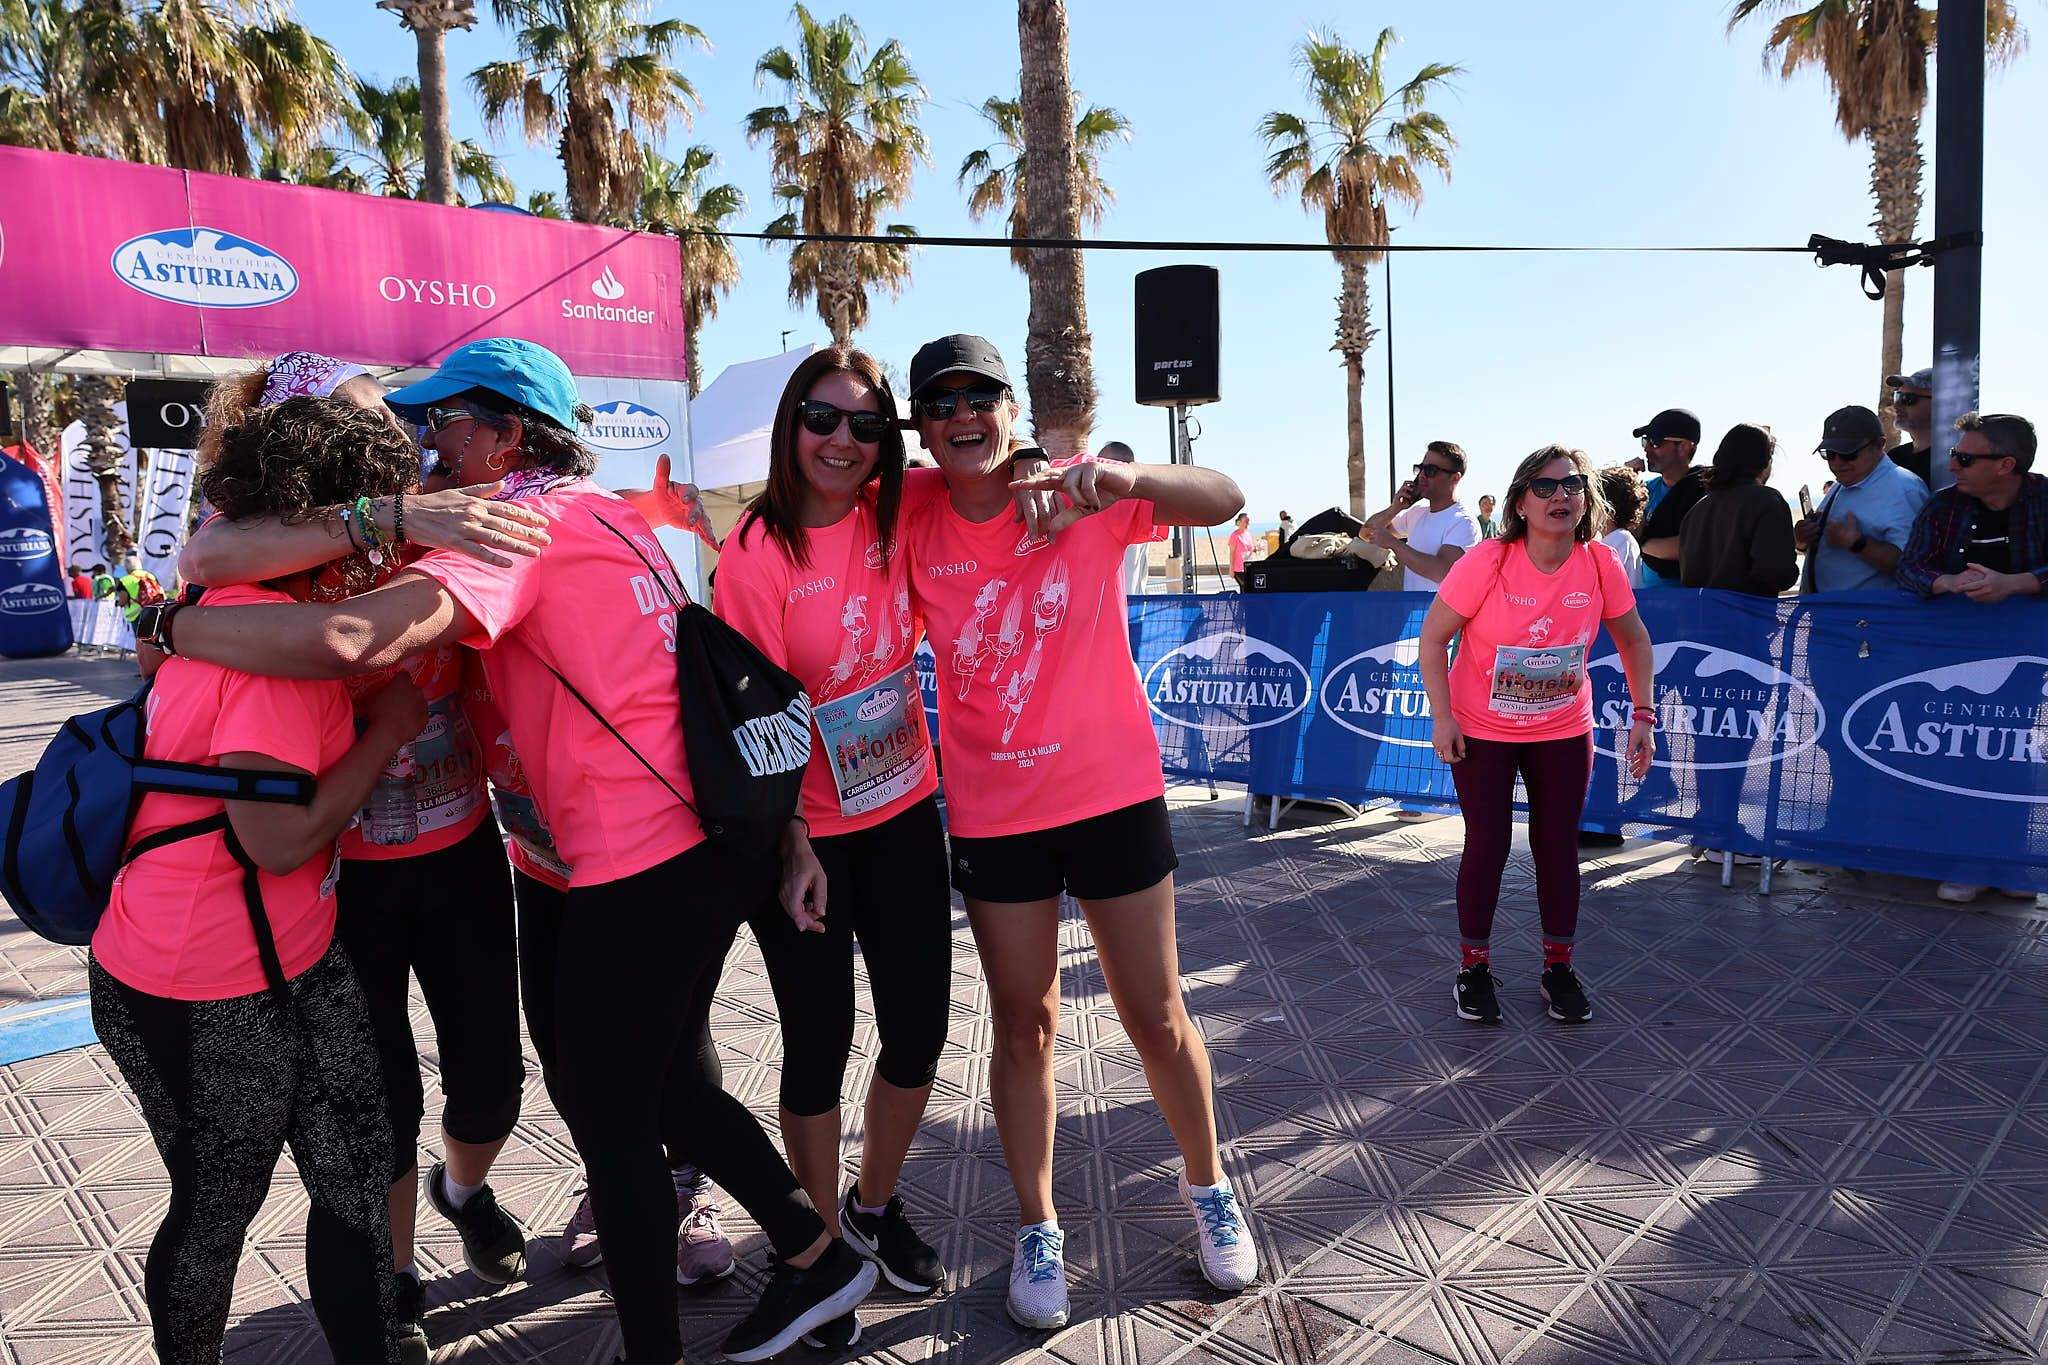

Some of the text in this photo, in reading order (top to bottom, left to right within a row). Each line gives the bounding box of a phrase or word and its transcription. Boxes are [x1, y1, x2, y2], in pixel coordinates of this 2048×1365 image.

[130, 250, 286, 292] ASTURIANA
[221, 257, 278, 269] LECHERA
[379, 276, 496, 309] OYSHO
[562, 300, 655, 324] Santander
[160, 403, 208, 428] OY
[582, 421, 664, 439] ASTURIANA
[144, 449, 189, 559] OYSH
[928, 560, 978, 580] OYSHO
[789, 577, 836, 603] OYSHO
[1180, 665, 1293, 678] CENTRAL LECHERA
[1152, 667, 1297, 708] ASTURIANA
[1607, 681, 1692, 697] CERAL
[860, 695, 899, 719] ASTURIANA
[1924, 701, 2038, 719] CENTRAL
[1594, 699, 1802, 743] STURIANA
[1864, 701, 2048, 764] ASTUR
[1017, 750, 1027, 759] DE
[1028, 748, 1037, 757] LA
[1037, 742, 1061, 756] MUJER
[1017, 758, 1035, 768] 2024
[847, 779, 876, 798] CARRERA
[876, 775, 885, 786] DE
[885, 770, 894, 781] LA
[893, 761, 910, 778] MUJER
[423, 799, 434, 809] LA
[855, 785, 892, 808] OYSHO
